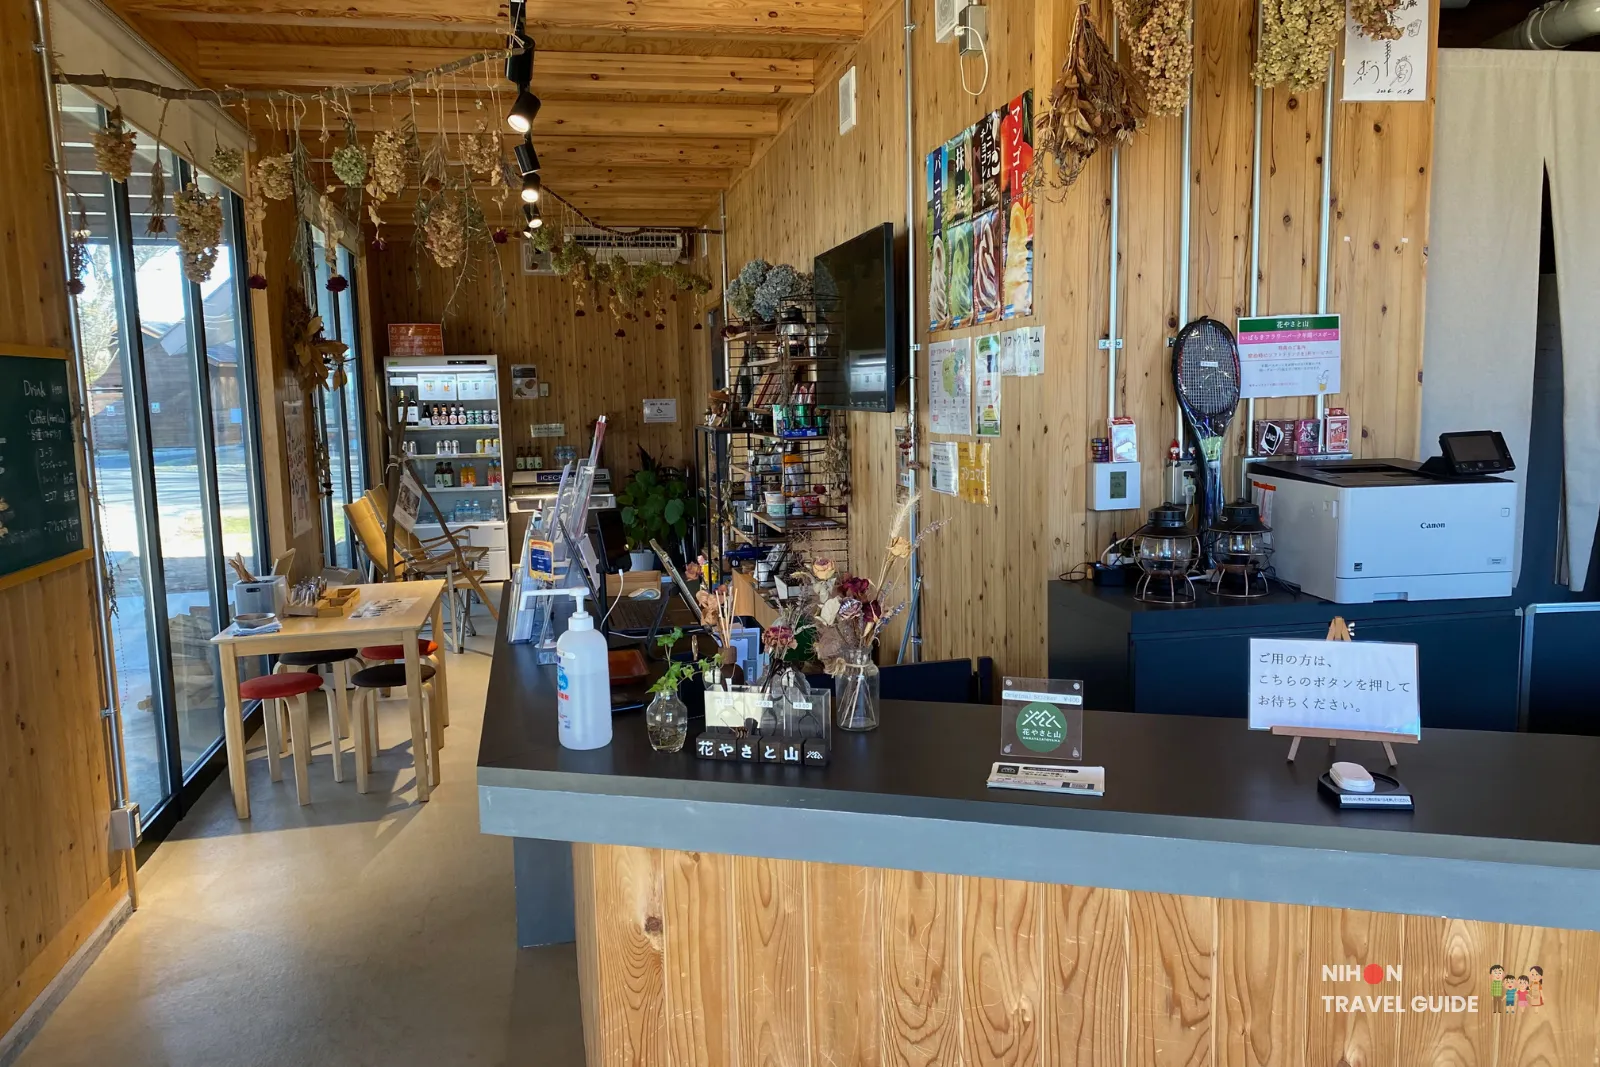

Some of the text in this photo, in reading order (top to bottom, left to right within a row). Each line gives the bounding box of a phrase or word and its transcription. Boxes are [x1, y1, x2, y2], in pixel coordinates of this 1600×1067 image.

[1010, 104, 1022, 192] マンゴー
[954, 146, 966, 209] 抹茶
[979, 128, 987, 208] チョコレート
[933, 153, 943, 219] バニラ
[1276, 320, 1309, 329] 花やさと山
[23, 379, 46, 398] Drink
[1265, 432, 1276, 442] UNO
[1420, 521, 1446, 530] Canon
[1259, 653, 1333, 668] ご用の方は、
[1259, 674, 1411, 693] こちらのボタンを押して
[1258, 694, 1362, 713] お待ちください。
[1022, 728, 1061, 739] 花やさと山
[698, 740, 799, 761] 花やさと山
